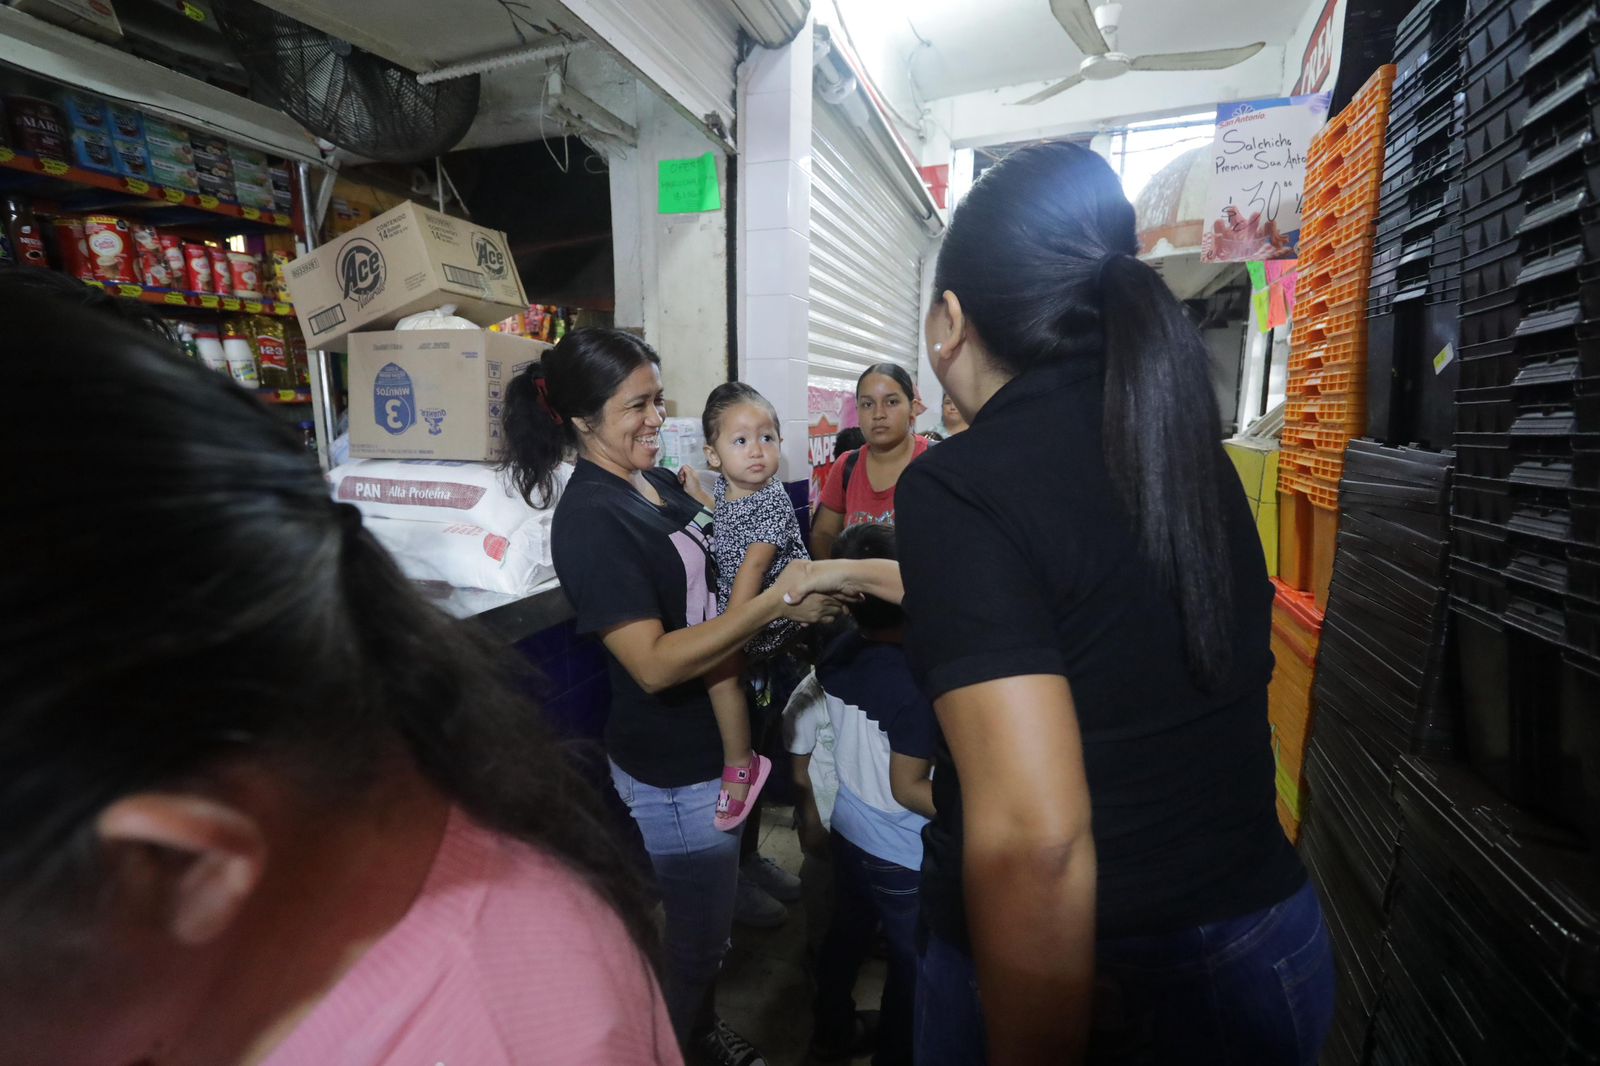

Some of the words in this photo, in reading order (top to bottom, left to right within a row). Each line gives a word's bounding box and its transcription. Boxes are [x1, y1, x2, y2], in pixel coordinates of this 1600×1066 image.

[477, 241, 504, 266] Ace
[343, 250, 380, 300] Ace
[375, 386, 411, 397] MINUTOS
[385, 399, 402, 430] 3
[355, 483, 381, 498] PAN
